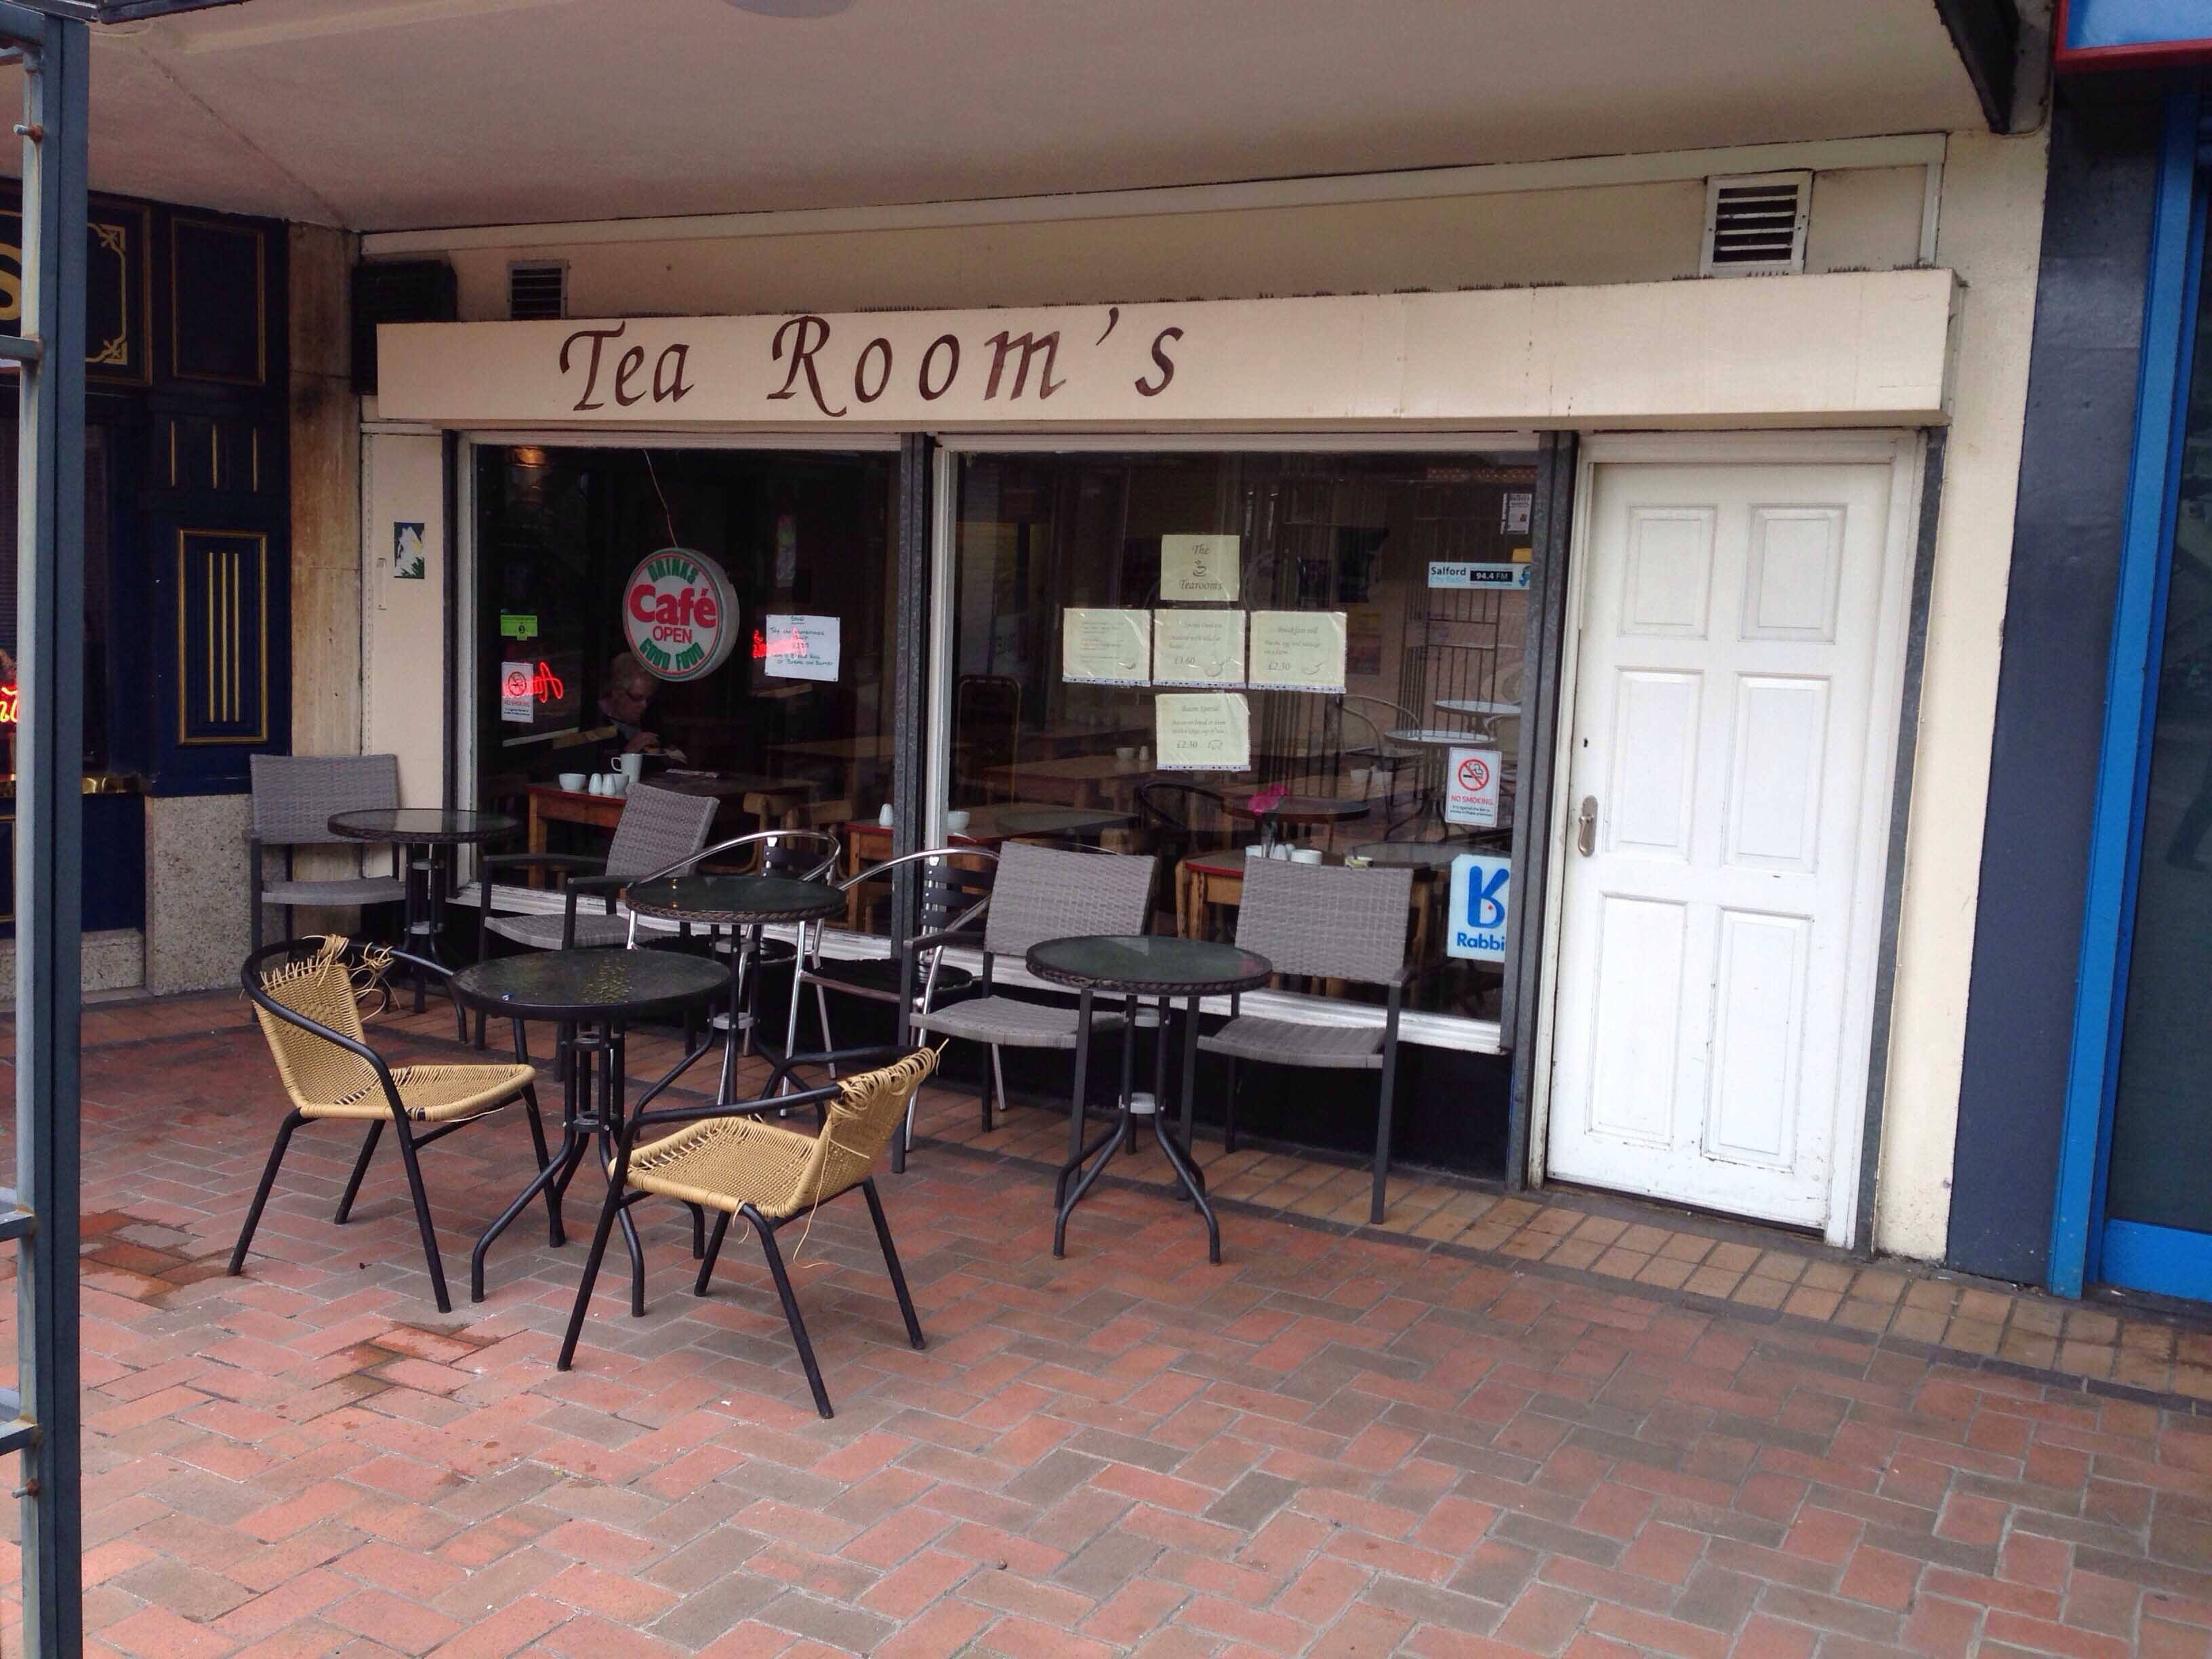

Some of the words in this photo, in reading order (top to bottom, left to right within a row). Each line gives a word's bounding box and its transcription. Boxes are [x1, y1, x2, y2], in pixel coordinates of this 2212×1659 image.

[560, 321, 695, 411] Tea
[766, 307, 1184, 417] Room's
[1191, 544, 1210, 555] The
[647, 558, 699, 585] DRINKS
[1431, 567, 1467, 575] Salford
[1475, 572, 1494, 580] 94.4
[1179, 579, 1223, 590] Tearooms
[629, 584, 717, 628] Café
[652, 625, 693, 644] OPEN
[639, 638, 671, 670] GOOD
[675, 642, 705, 671] FOOD
[1462, 796, 1493, 805] SMOKING
